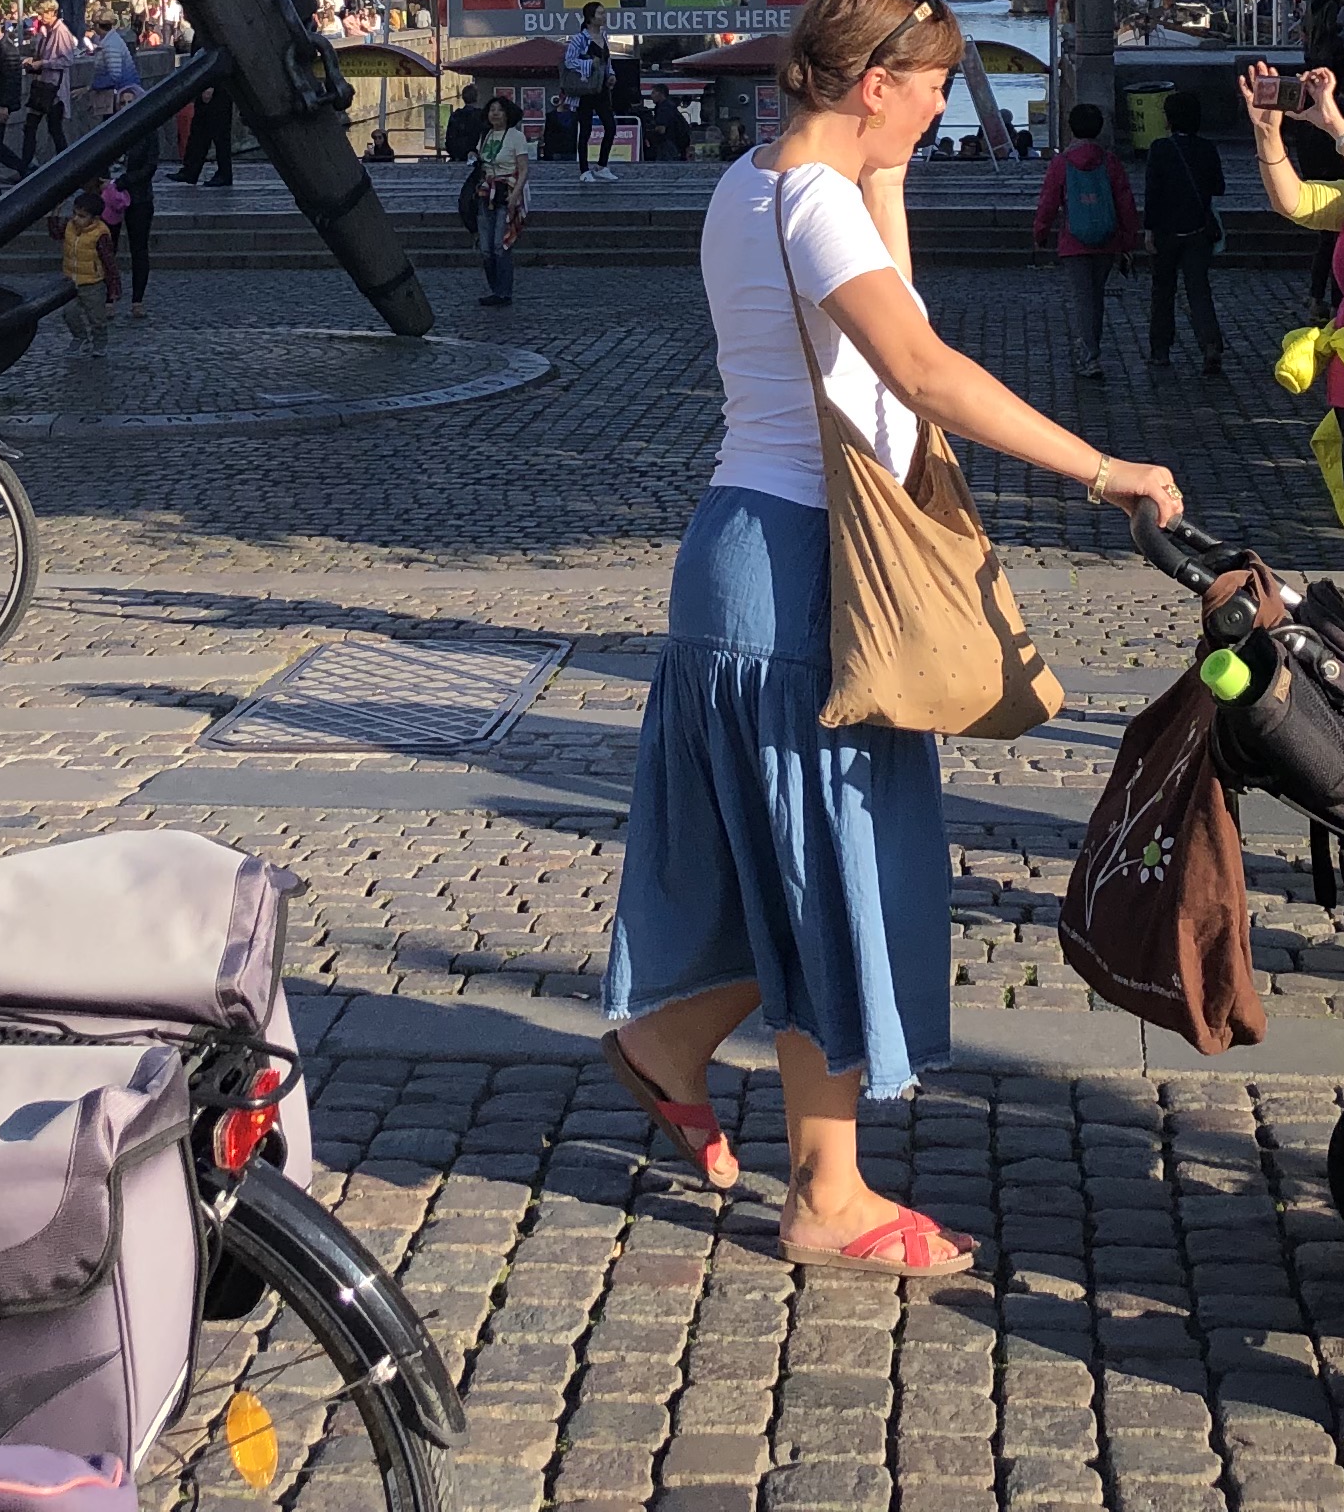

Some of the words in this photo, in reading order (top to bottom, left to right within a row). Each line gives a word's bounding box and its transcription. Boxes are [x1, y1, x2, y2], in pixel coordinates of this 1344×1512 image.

[524, 12, 569, 32] BUY
[574, 11, 637, 31] YUR
[643, 10, 729, 30] TICKETS
[735, 9, 791, 29] HERE
